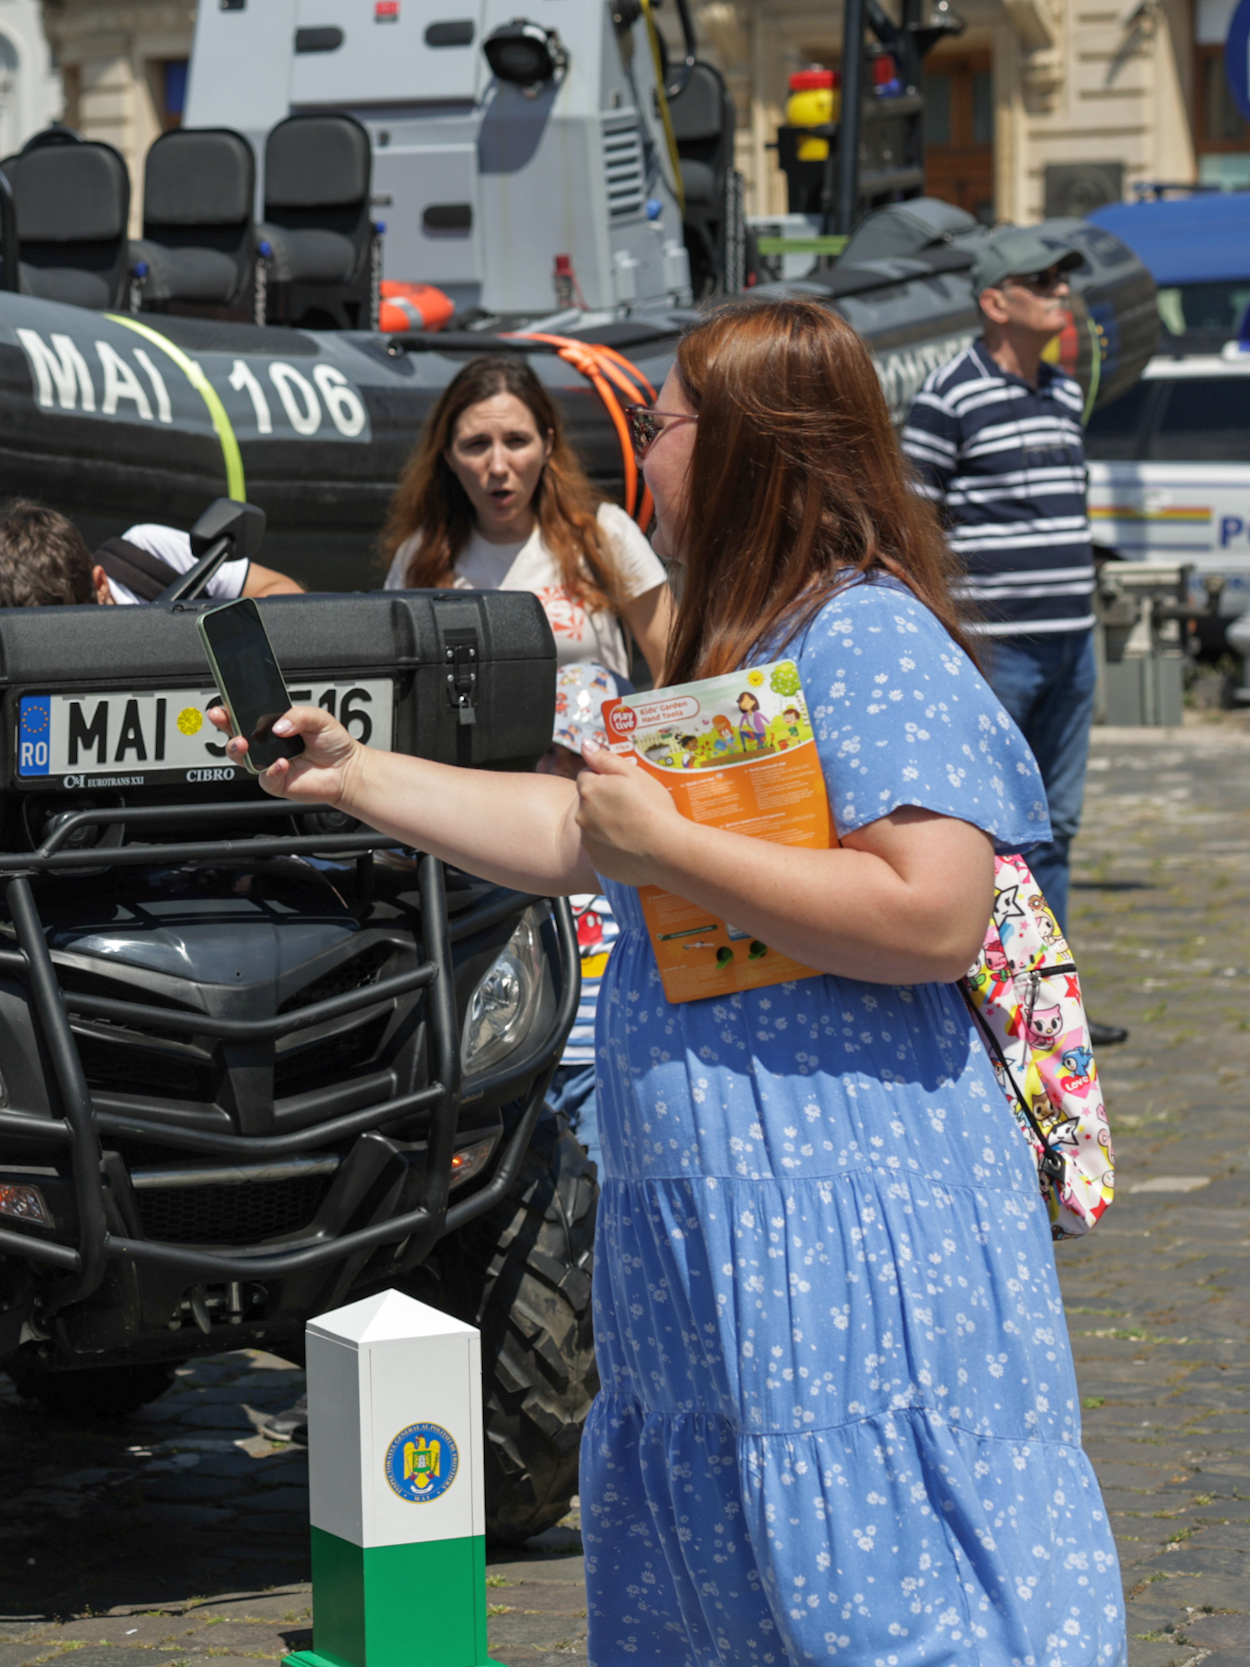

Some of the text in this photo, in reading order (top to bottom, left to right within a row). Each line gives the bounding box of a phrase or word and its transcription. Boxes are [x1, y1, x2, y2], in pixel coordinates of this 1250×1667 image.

[16, 328, 365, 437] MAI 106
[1219, 515, 1250, 547] P
[660, 701, 687, 711] Garden
[613, 712, 633, 722] Play
[642, 710, 683, 723] Hand Tools
[67, 698, 167, 765] MAI
[21, 741, 48, 767] RO
[87, 776, 130, 788] EUROTRANS
[130, 775, 145, 786] XXI
[185, 767, 236, 783] CIBRO
[1065, 1076, 1090, 1092] Love
